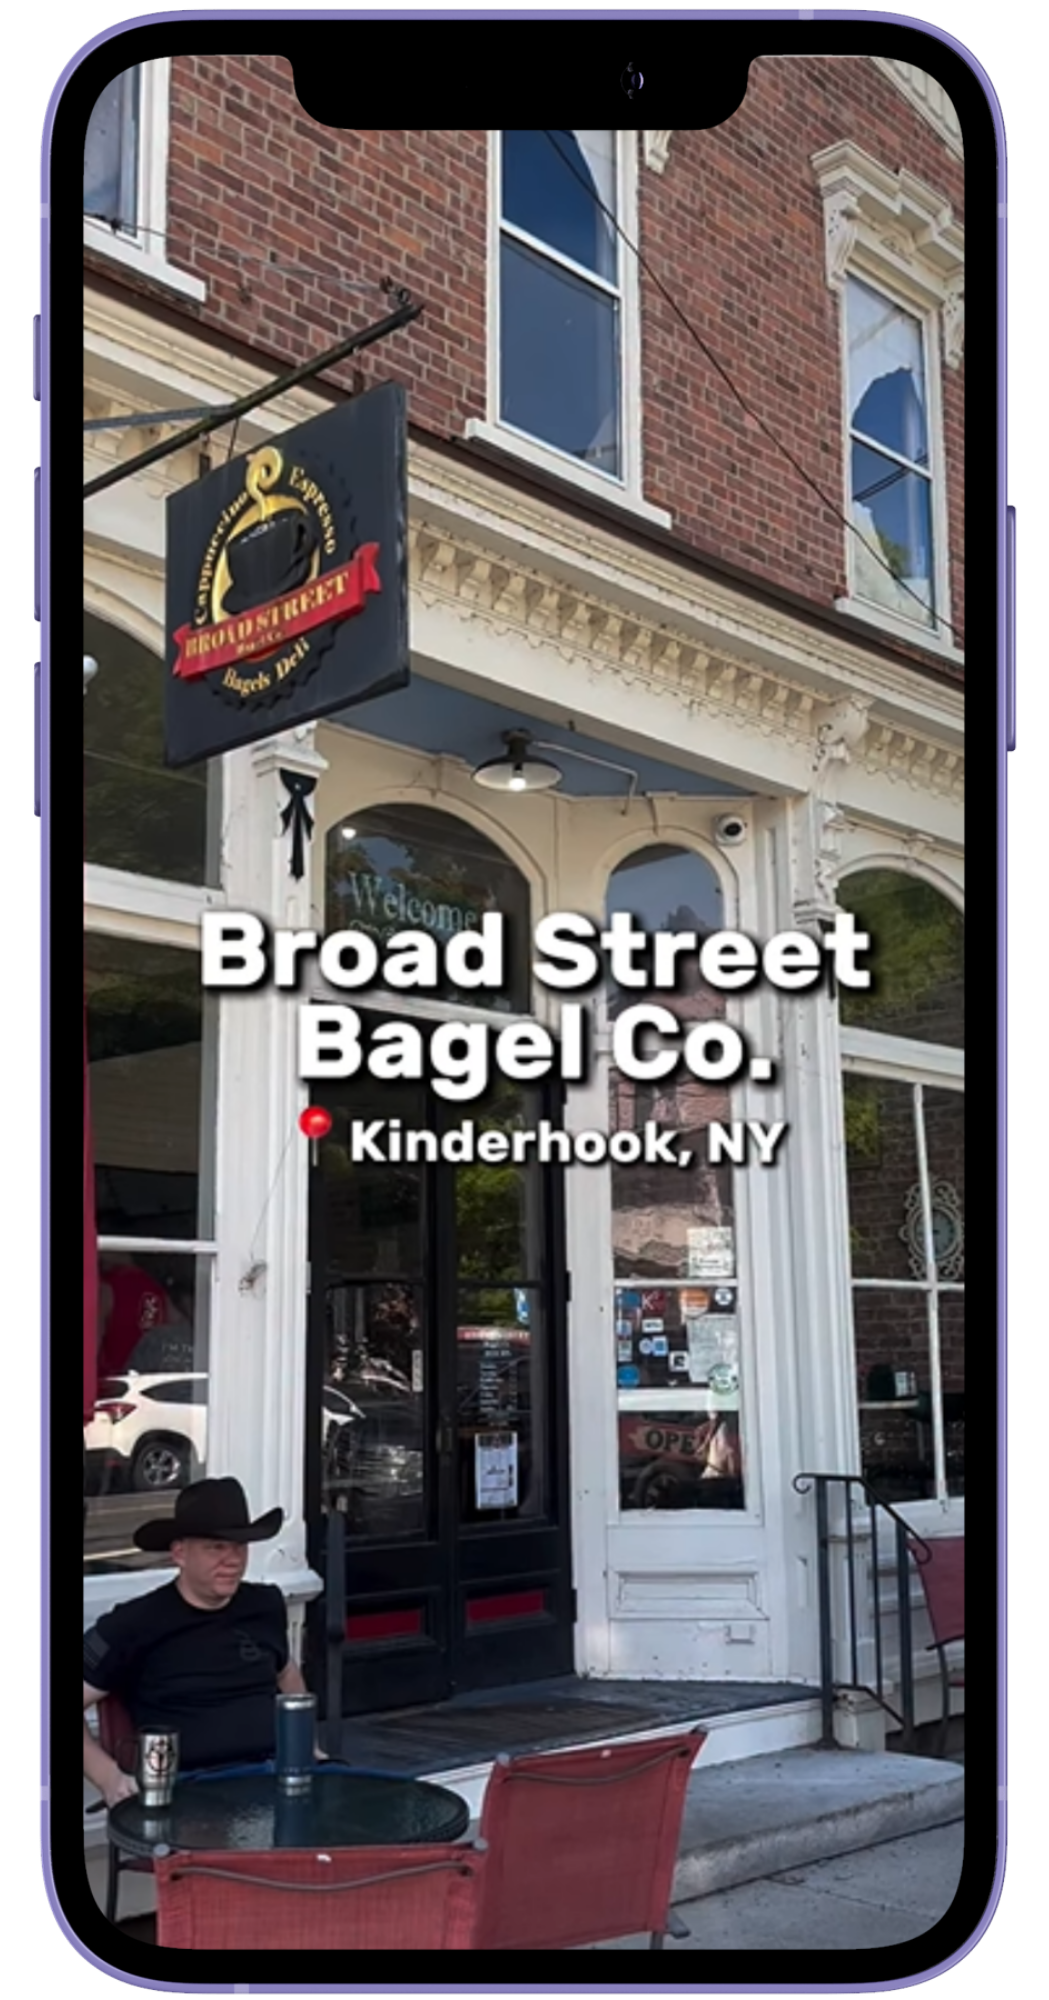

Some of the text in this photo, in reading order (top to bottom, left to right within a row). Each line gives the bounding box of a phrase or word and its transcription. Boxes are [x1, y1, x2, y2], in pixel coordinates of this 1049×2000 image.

[194, 466, 337, 625] Cappuccino Espresso
[184, 570, 349, 660] BROAD STREET
[222, 636, 310, 697] Bagels Deli
[348, 870, 478, 931] Welcome
[645, 1428, 696, 1456] OPE
